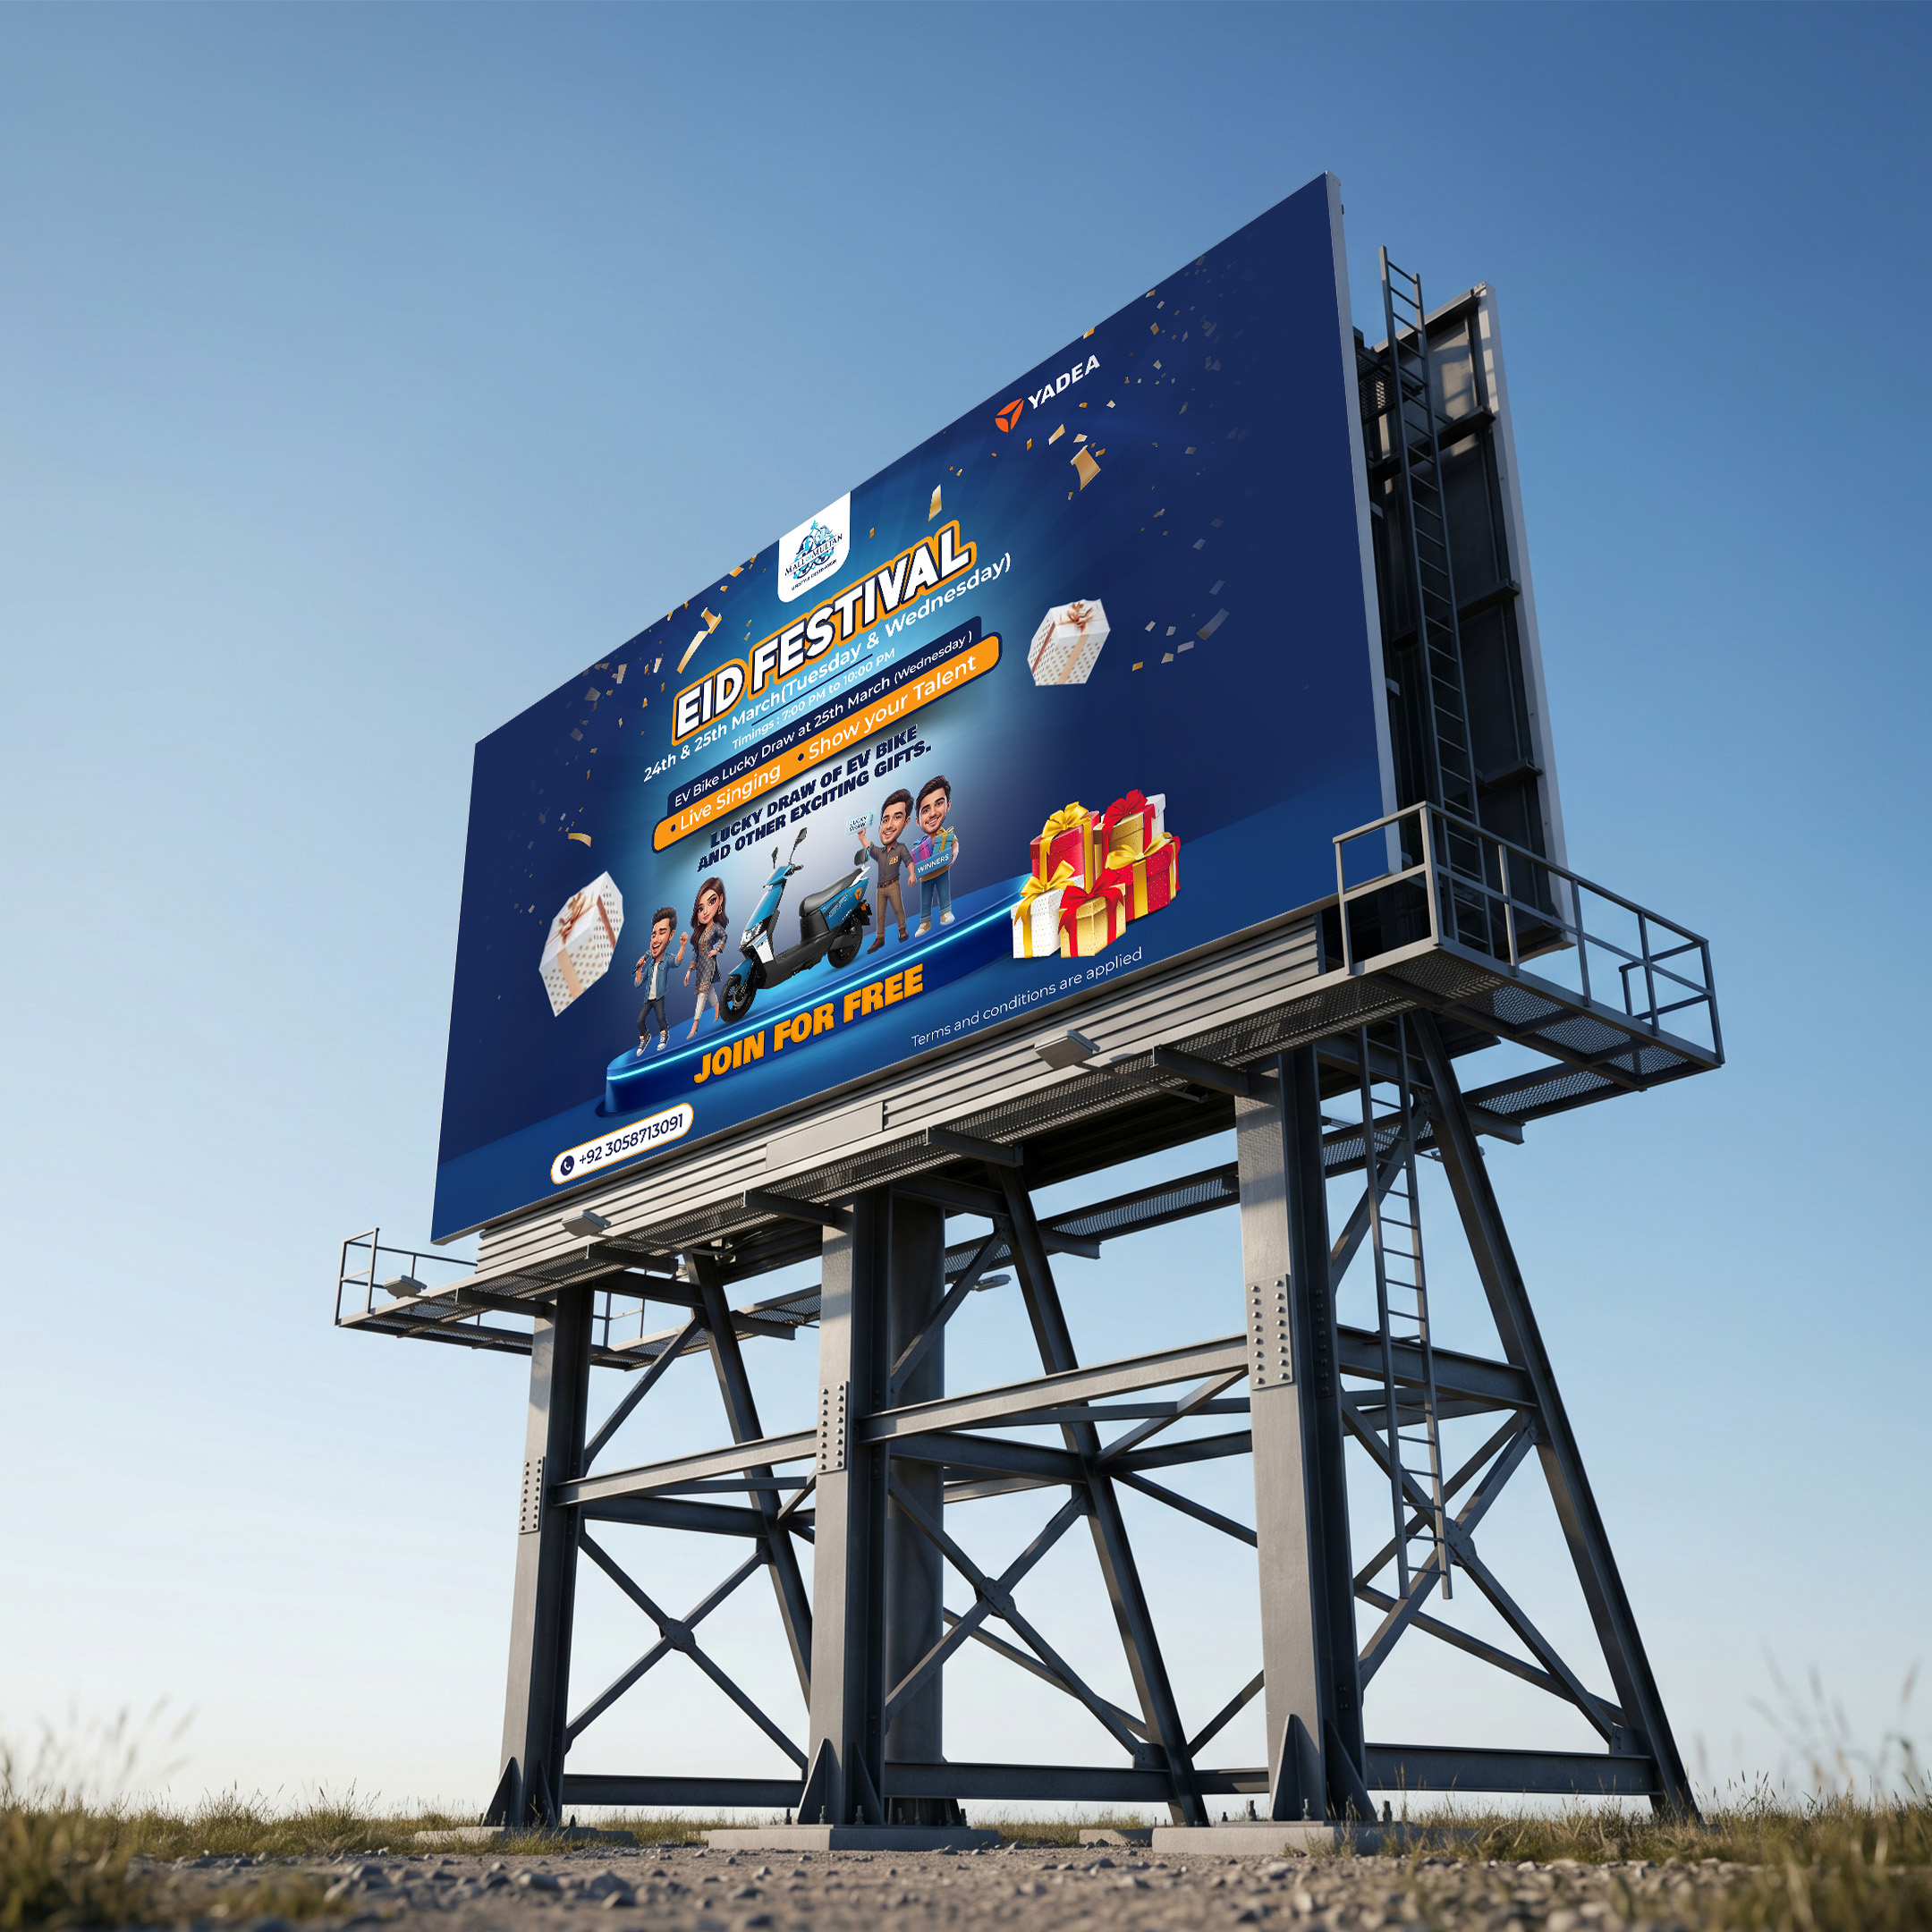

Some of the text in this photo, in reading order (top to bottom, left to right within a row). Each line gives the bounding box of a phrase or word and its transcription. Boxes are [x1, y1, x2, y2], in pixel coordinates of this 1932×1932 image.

[1028, 354, 1100, 409] YADEA
[785, 559, 805, 576] MALL
[812, 533, 843, 558] MULTAN
[643, 753, 676, 783] 24th
[680, 745, 691, 759] &
[694, 724, 727, 752] 25th
[867, 631, 879, 649] &
[885, 552, 1011, 638] Wednesday)
[674, 525, 972, 741] EID FESTIVAL
[675, 788, 691, 807] EV
[693, 775, 719, 797] Bike
[722, 752, 758, 780] Lucky
[761, 732, 795, 758] Draw
[798, 722, 811, 737] at
[814, 704, 843, 728] 25th
[848, 677, 889, 708] March
[681, 655, 976, 830] Live Singing Show your Talent
[732, 719, 775, 750] Timings
[782, 701, 805, 721] 7:00
[809, 690, 826, 706] PM
[828, 682, 840, 694] to
[843, 660, 873, 685] 10:00
[876, 648, 894, 666] PM
[697, 740, 932, 872] AND OTHER EXCITING GIFTS.
[710, 724, 918, 848] LUCKY DRAW OF EV BIKE
[917, 853, 949, 873] WINNERS
[693, 963, 923, 1083] JOIN FOR FREE
[911, 946, 1142, 1047] Terms and conditions are applied
[580, 1113, 682, 1164] +92 3058713091
